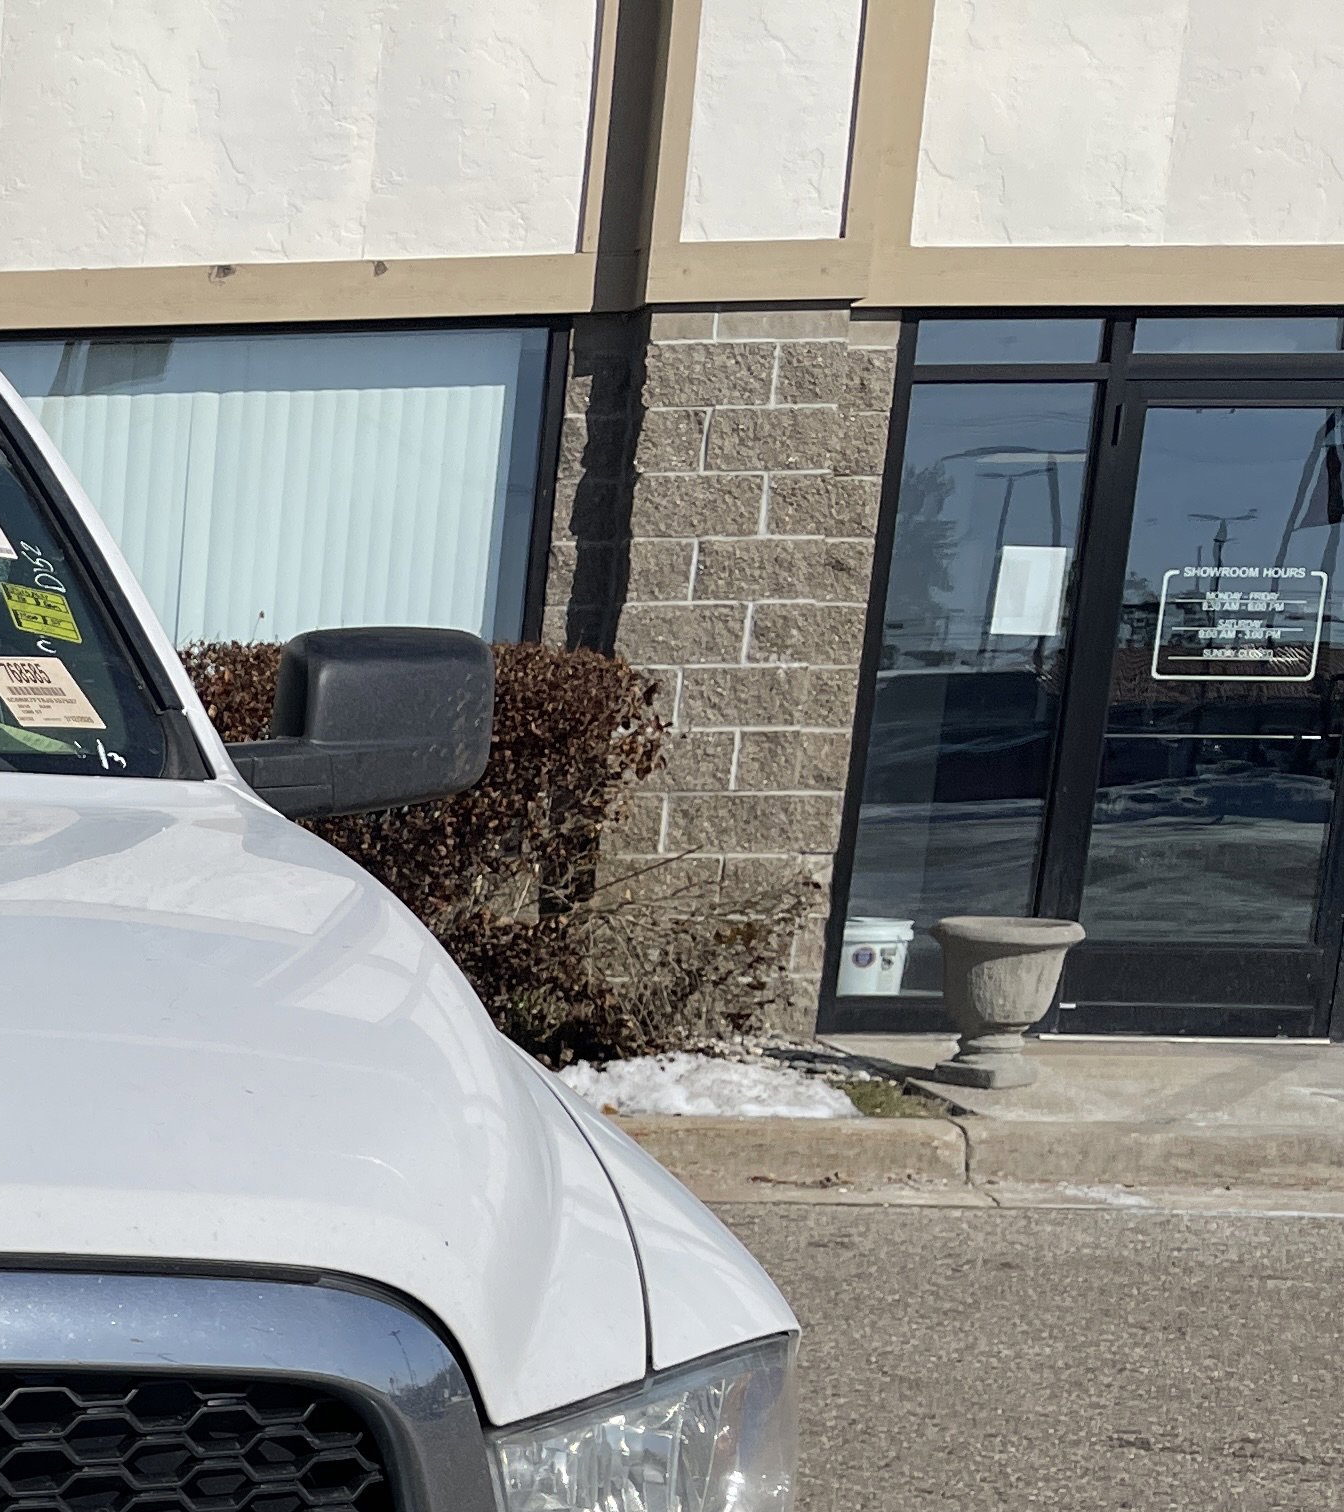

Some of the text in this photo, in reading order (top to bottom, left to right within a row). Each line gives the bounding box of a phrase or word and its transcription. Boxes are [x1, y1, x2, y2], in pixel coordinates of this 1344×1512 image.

[1183, 566, 1306, 579] SHOWROOM HOURS
[1205, 591, 1243, 601] MONDAY
[1249, 592, 1280, 601] FRIDAY
[1222, 602, 1240, 611] AM
[1268, 602, 1285, 612] PM
[1216, 619, 1263, 629] SATURDAY
[1219, 629, 1236, 639] AM
[1265, 629, 1281, 639] PM
[1203, 649, 1237, 658] SUNDAY
